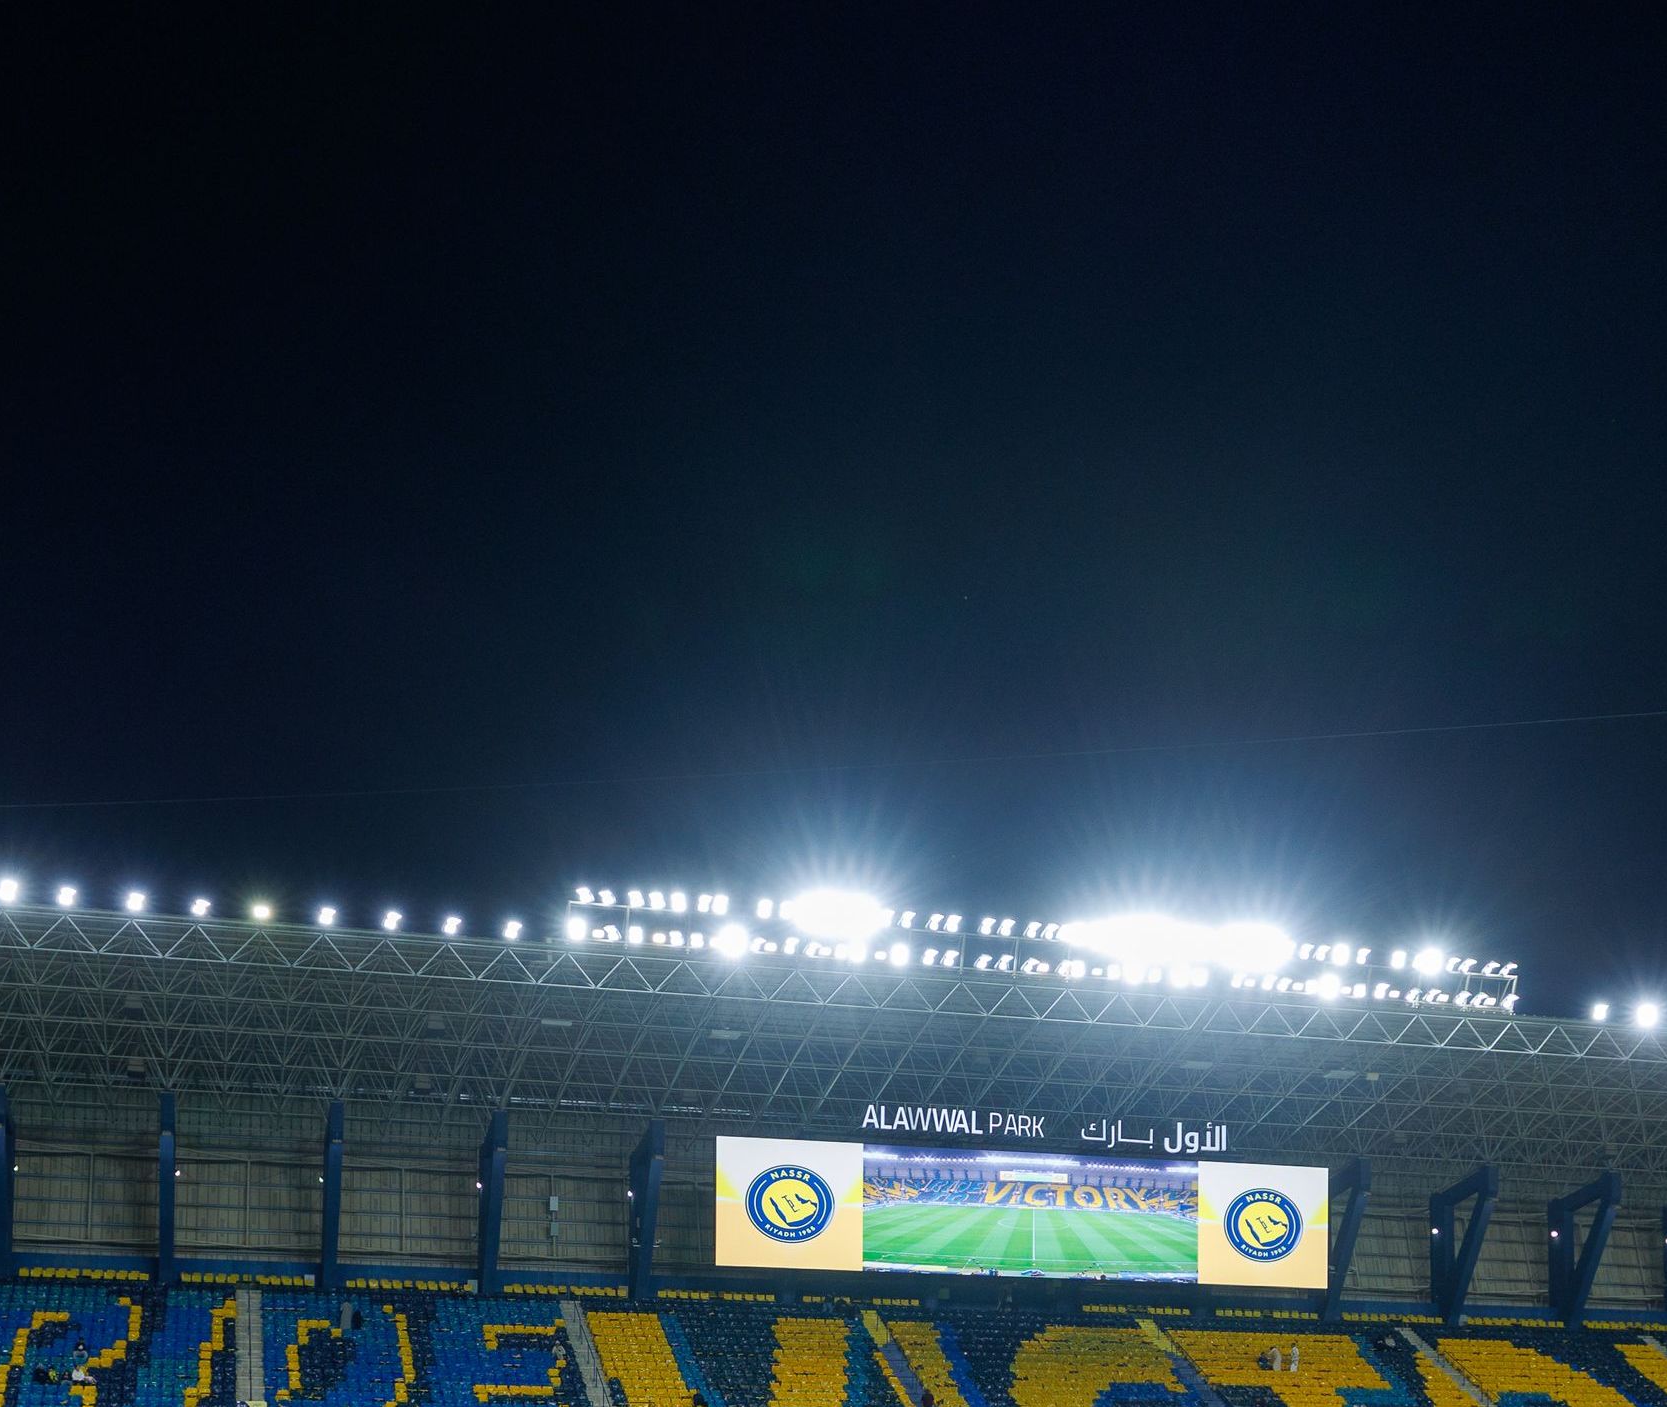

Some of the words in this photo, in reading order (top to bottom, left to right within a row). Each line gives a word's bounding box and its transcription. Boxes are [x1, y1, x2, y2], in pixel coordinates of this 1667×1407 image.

[861, 1104, 983, 1135] ALAWWAL
[988, 1112, 1046, 1138] PARK
[1163, 1121, 1227, 1154] الأول
[769, 1169, 811, 1182] NASSR
[984, 1181, 1149, 1210] VICTORY
[1245, 1192, 1282, 1204] NASSR
[764, 1223, 796, 1238] RIYADH
[1240, 1244, 1268, 1257] RIYADH
